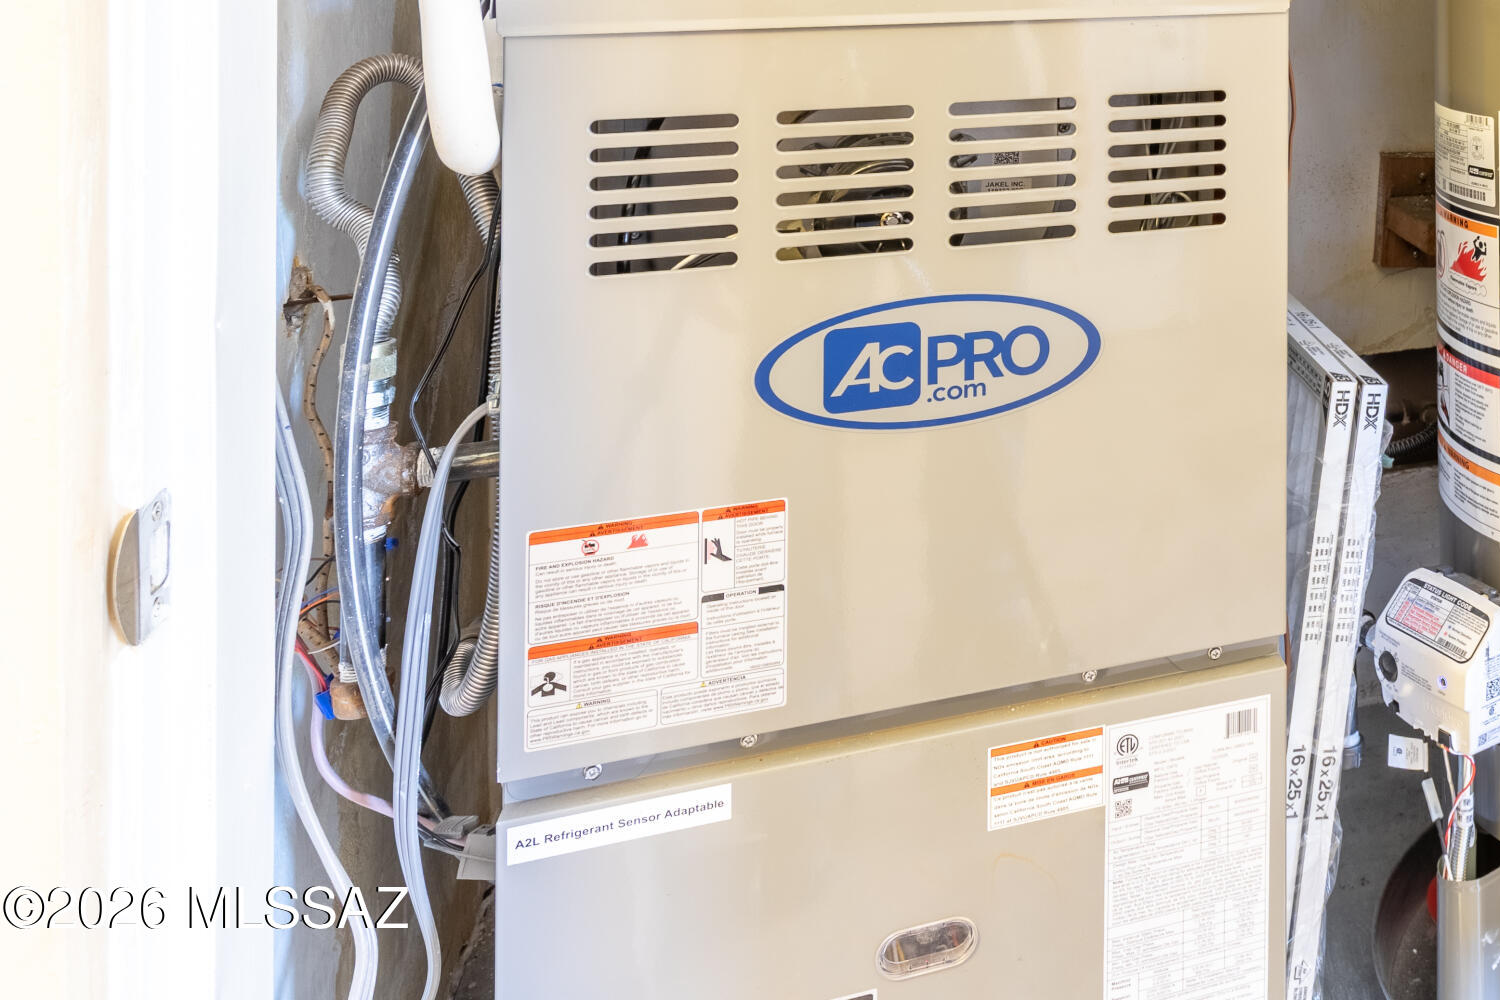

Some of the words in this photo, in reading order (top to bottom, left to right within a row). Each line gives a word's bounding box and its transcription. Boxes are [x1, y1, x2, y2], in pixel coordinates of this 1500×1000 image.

[830, 342, 915, 398] AC
[927, 324, 1050, 386] PRO
[1446, 355, 1467, 374] DANGER
[926, 382, 986, 402] .com
[1333, 390, 1350, 427] HDX
[1363, 393, 1381, 430] HDX
[561, 559, 591, 568] EXPLOSION
[726, 590, 756, 598] OPERATION
[1424, 583, 1442, 595] STATUS
[1441, 592, 1457, 603] LIGHT
[1456, 599, 1473, 611] CODE
[584, 698, 611, 706] WARNING
[1041, 737, 1066, 746] CAUTION
[515, 837, 540, 849] A2L
[544, 822, 614, 843] Refrigerant
[618, 811, 661, 829] Sensor
[664, 799, 724, 818] Adaptable
